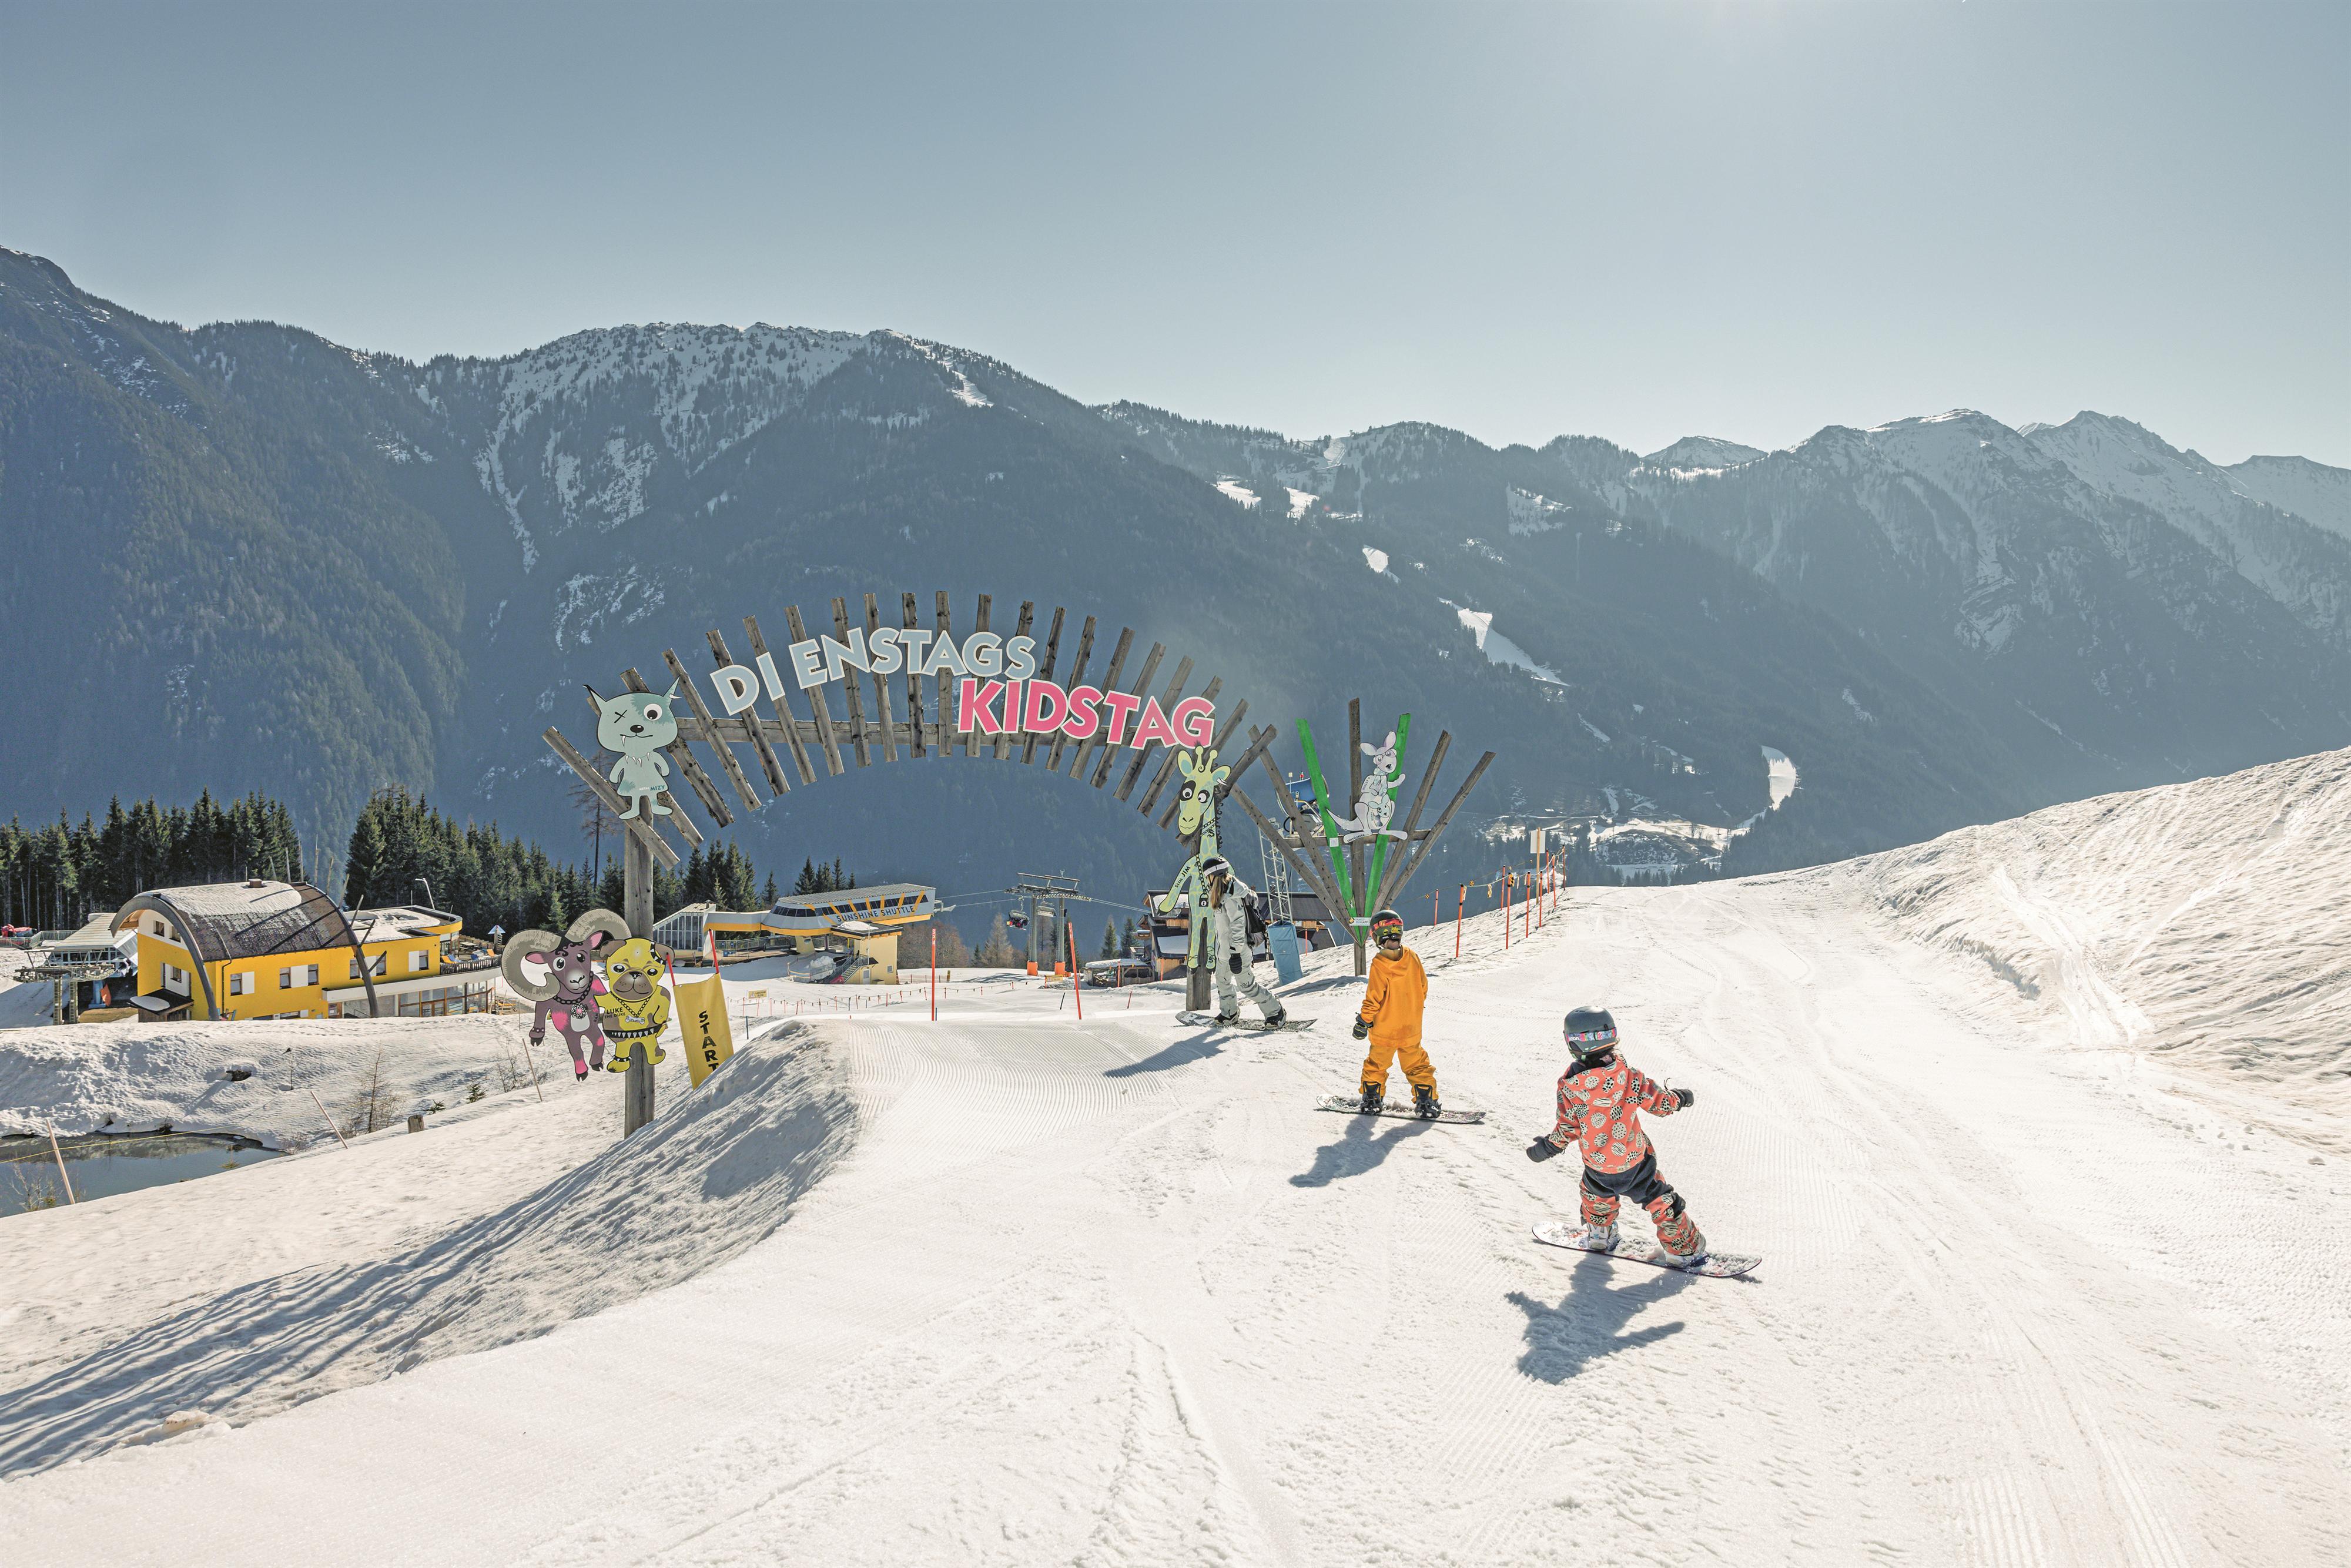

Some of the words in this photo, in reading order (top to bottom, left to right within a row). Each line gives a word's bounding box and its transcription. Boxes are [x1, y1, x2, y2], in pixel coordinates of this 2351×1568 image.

[958, 678, 1216, 750] KIDSTAG
[1175, 878, 1183, 888] SLIM
[1181, 866, 1191, 877] JIM
[836, 910, 879, 922] SUNSHINE
[880, 906, 915, 916] SHUTTLE
[589, 999, 598, 1012] SAM
[698, 1010, 719, 1071] START
